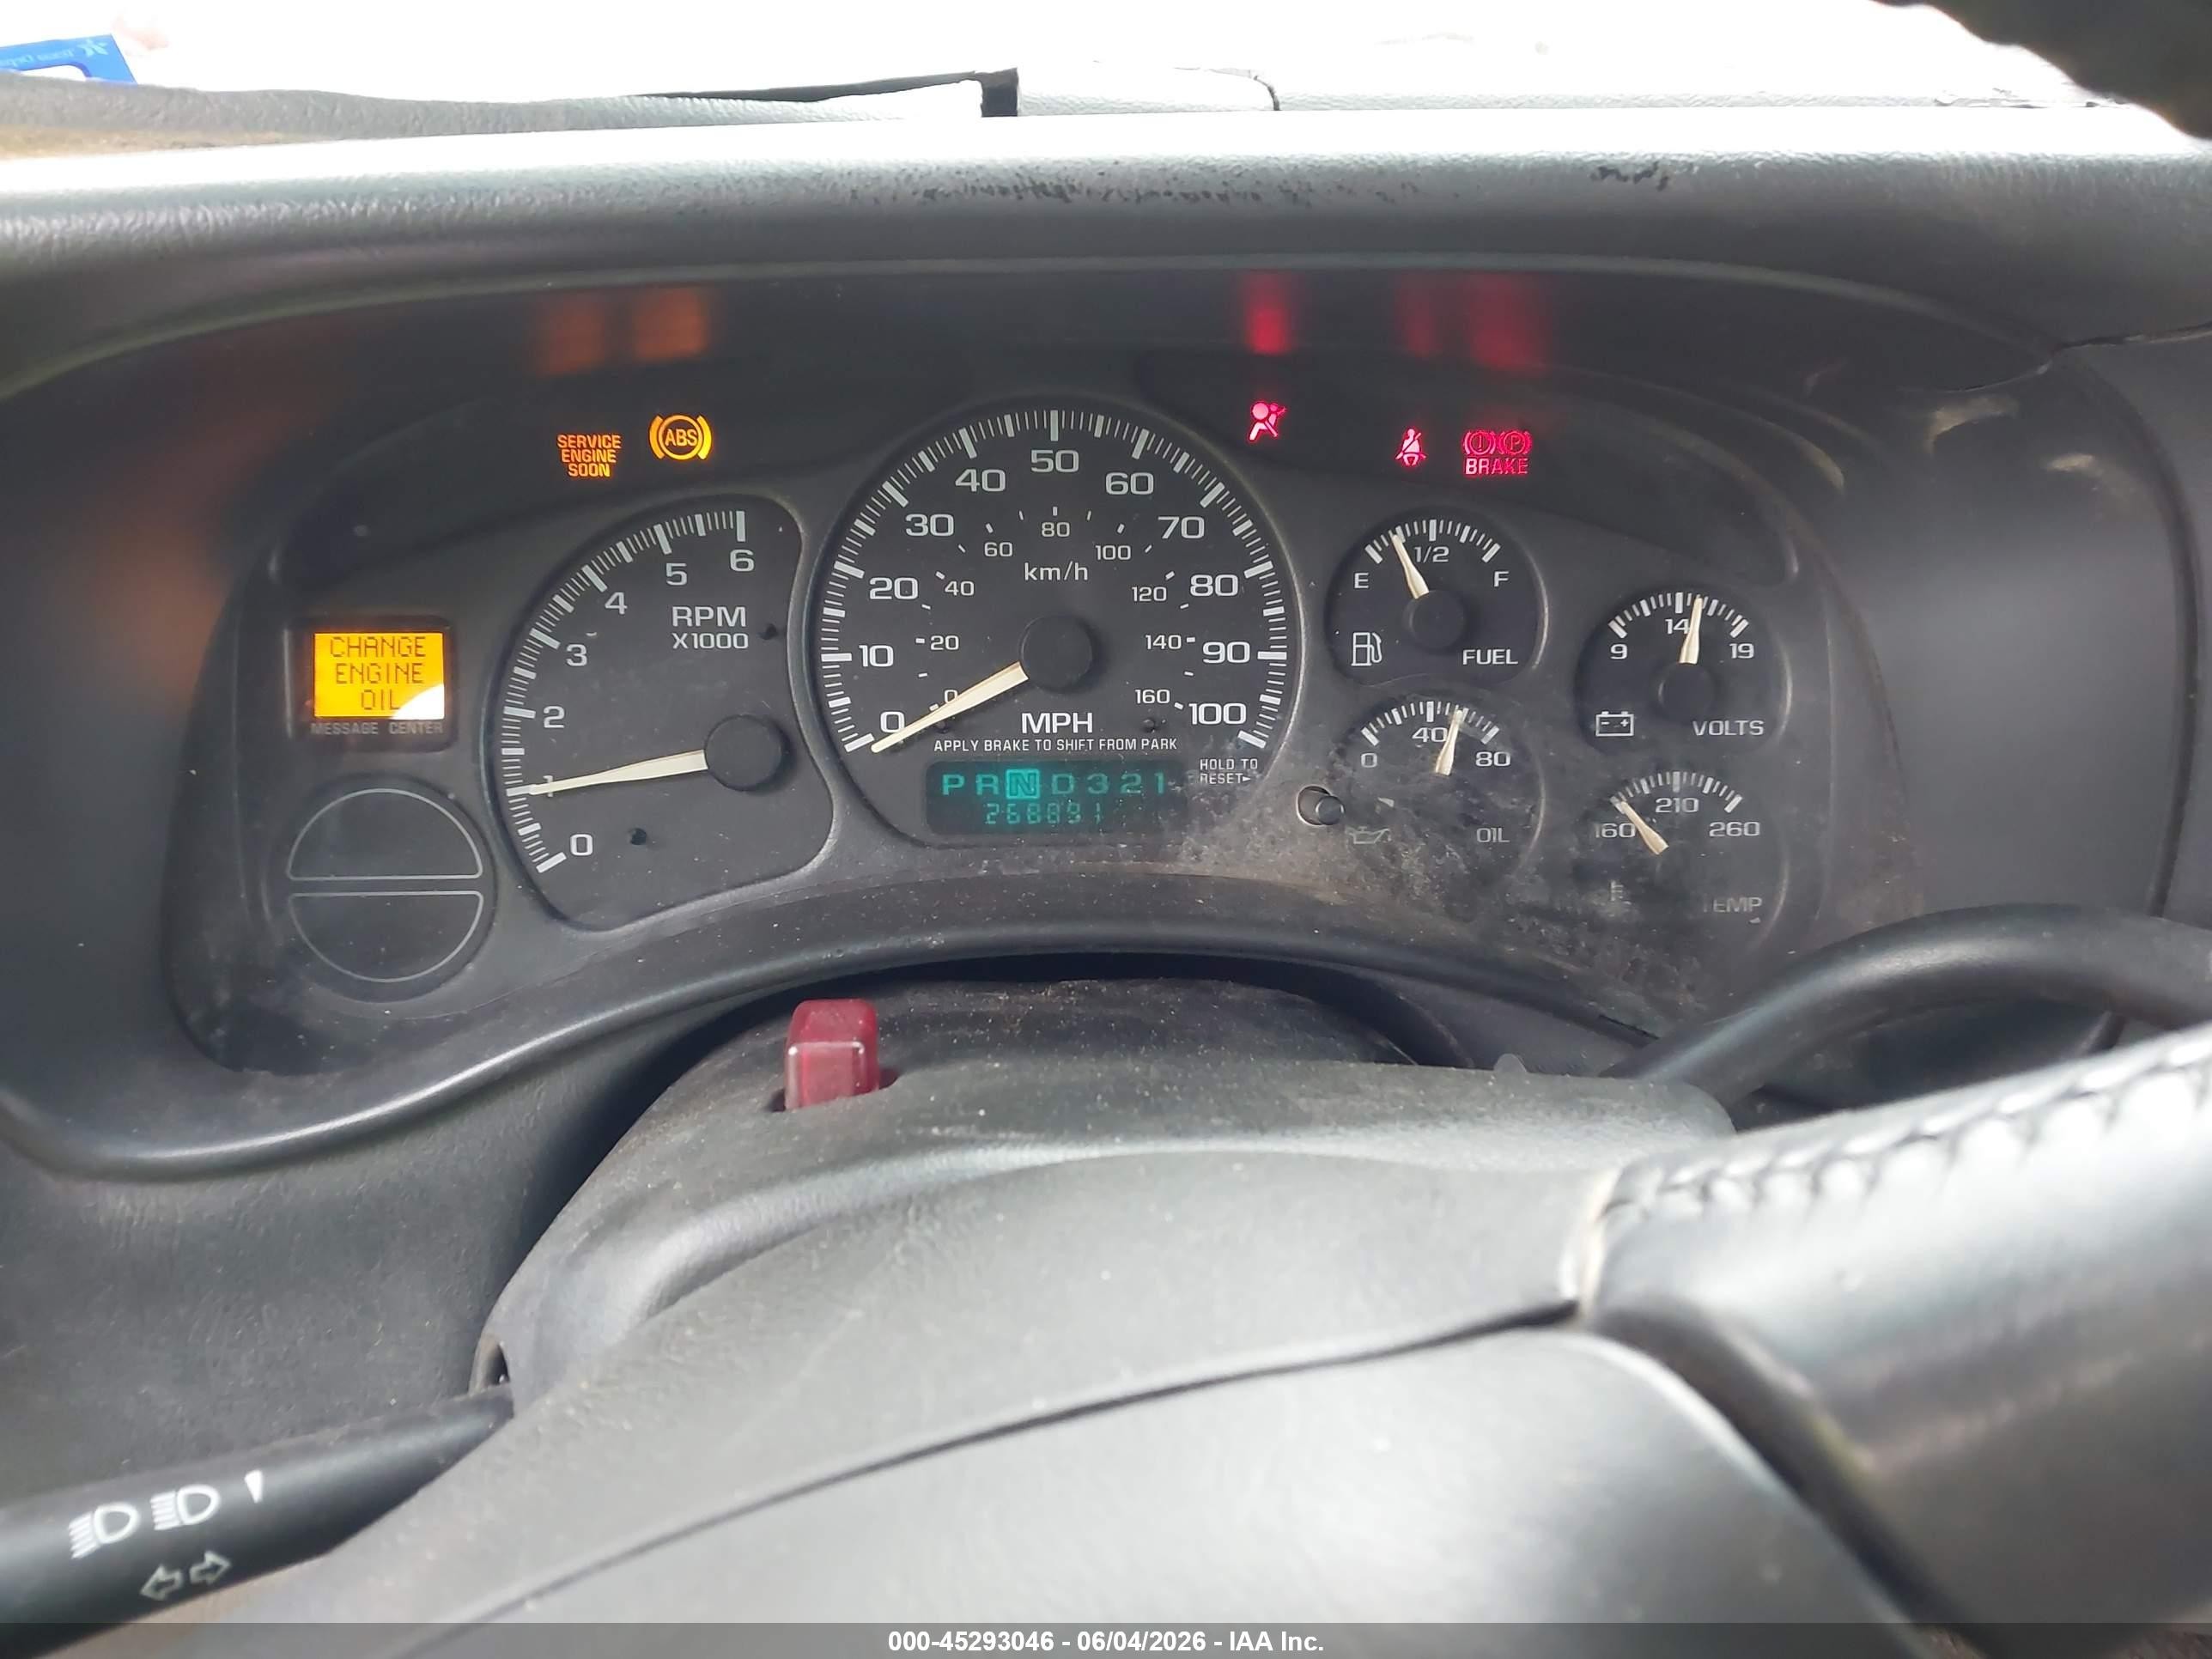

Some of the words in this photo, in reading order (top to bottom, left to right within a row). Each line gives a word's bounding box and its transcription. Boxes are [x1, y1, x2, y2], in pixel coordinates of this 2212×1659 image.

[558, 434, 622, 449] SERVICE
[665, 429, 698, 447] ABS
[562, 449, 617, 463] ENGINE
[1031, 449, 1079, 472] 50
[568, 464, 611, 477] SOON
[1465, 458, 1528, 475] BRAKE
[955, 469, 1006, 492] 40
[1105, 472, 1154, 495] 60
[905, 514, 954, 537] 30
[1041, 522, 1070, 537] 80
[1158, 516, 1205, 539] 70
[984, 542, 1013, 556] 60
[1095, 545, 1131, 560] 100
[1414, 546, 1449, 562] 1/2
[730, 550, 755, 572] 6
[665, 562, 688, 586] 5
[1024, 561, 1088, 580] km/h
[1494, 571, 1510, 586] F
[869, 577, 919, 599] 20
[945, 581, 975, 596] 40
[1190, 574, 1238, 596] 80
[1354, 573, 1369, 588] E
[1132, 586, 1167, 601] 120
[605, 592, 628, 615] 4
[672, 606, 746, 627] RPM
[1664, 618, 1690, 635] 14
[330, 636, 426, 658] CHANGE
[672, 633, 749, 649] X1000
[930, 635, 959, 650] 20
[1146, 635, 1182, 650] 140
[566, 644, 588, 666] 3
[859, 645, 894, 667] 10
[1202, 641, 1250, 664] 90
[1462, 649, 1518, 665] FUEL
[1610, 644, 1628, 659] 9
[1729, 643, 1755, 659] 19
[336, 663, 425, 684] ENGINE
[361, 690, 401, 710] OIL
[945, 690, 958, 703] 0
[1135, 690, 1170, 704] 160
[543, 706, 565, 728] 2
[880, 711, 904, 733] 0
[1188, 703, 1246, 725] 100
[311, 723, 379, 735] MESSAGE
[389, 722, 443, 734] CENTER
[1022, 713, 1092, 733] MPH
[1692, 720, 1764, 736] VOLTS
[1412, 727, 1448, 743] 40
[933, 739, 979, 752] APPLY
[984, 739, 1030, 751] BRAKE
[1035, 739, 1051, 751] TO
[1056, 739, 1094, 751] SHIFT
[1099, 738, 1137, 750] FROM
[1141, 738, 1177, 750] PARK
[1200, 758, 1235, 770] HOLD
[1240, 758, 1258, 769] TO
[1361, 753, 1377, 768] 0
[1475, 751, 1511, 767] 80
[942, 775, 964, 795] P
[976, 775, 1000, 795] R
[1009, 774, 1037, 797] N
[1051, 775, 1074, 795] D
[1087, 774, 1109, 794] 3
[1120, 774, 1142, 793] 2
[1155, 774, 1164, 794] 1
[1200, 773, 1243, 784] RESET
[1656, 798, 1699, 813] 210
[1476, 827, 1510, 842] OIL
[1595, 823, 1636, 838] 160
[1709, 822, 1760, 837] 260
[569, 834, 593, 856] 0
